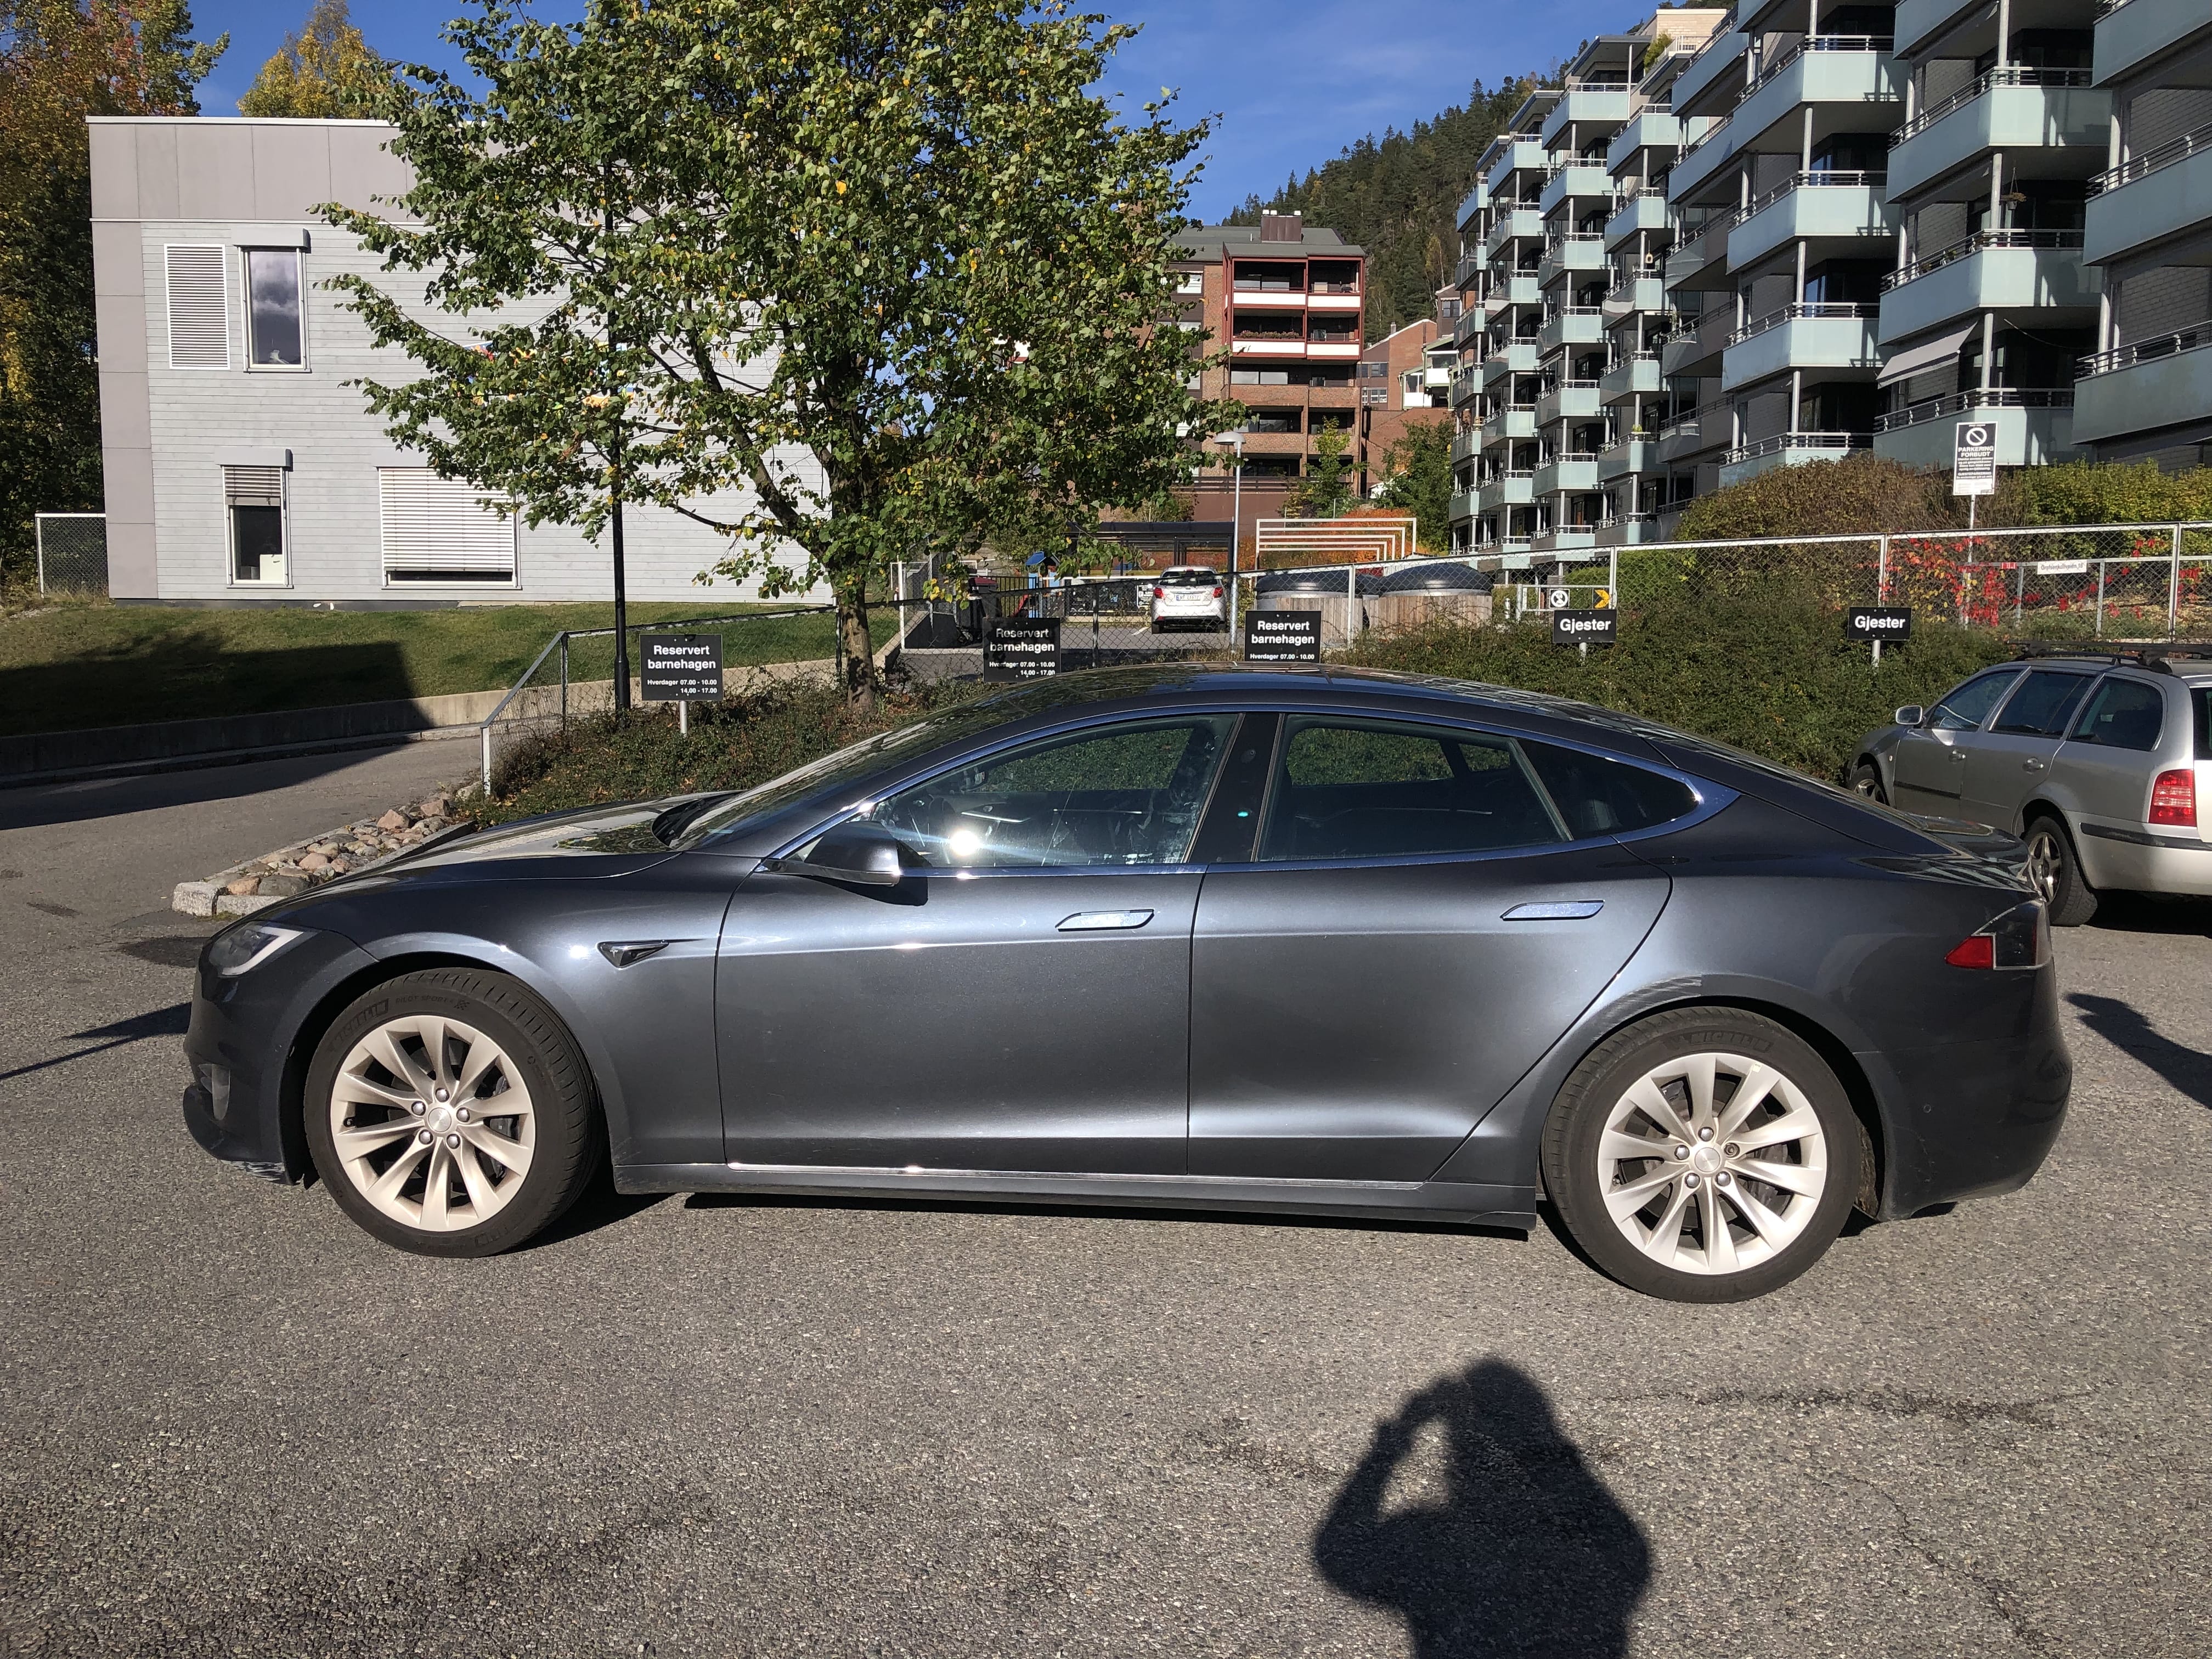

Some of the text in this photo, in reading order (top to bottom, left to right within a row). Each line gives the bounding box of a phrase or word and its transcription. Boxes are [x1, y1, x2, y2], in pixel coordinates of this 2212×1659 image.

[1257, 620, 1310, 630] Reservert
[1560, 618, 1611, 634] Gjester
[1855, 615, 1906, 631] Gjester
[996, 628, 1049, 638] Reservert
[1251, 634, 1314, 646] barnehagen
[653, 645, 710, 655] Reservert
[990, 641, 1054, 654] barnehagen
[647, 659, 716, 671] barnehagen
